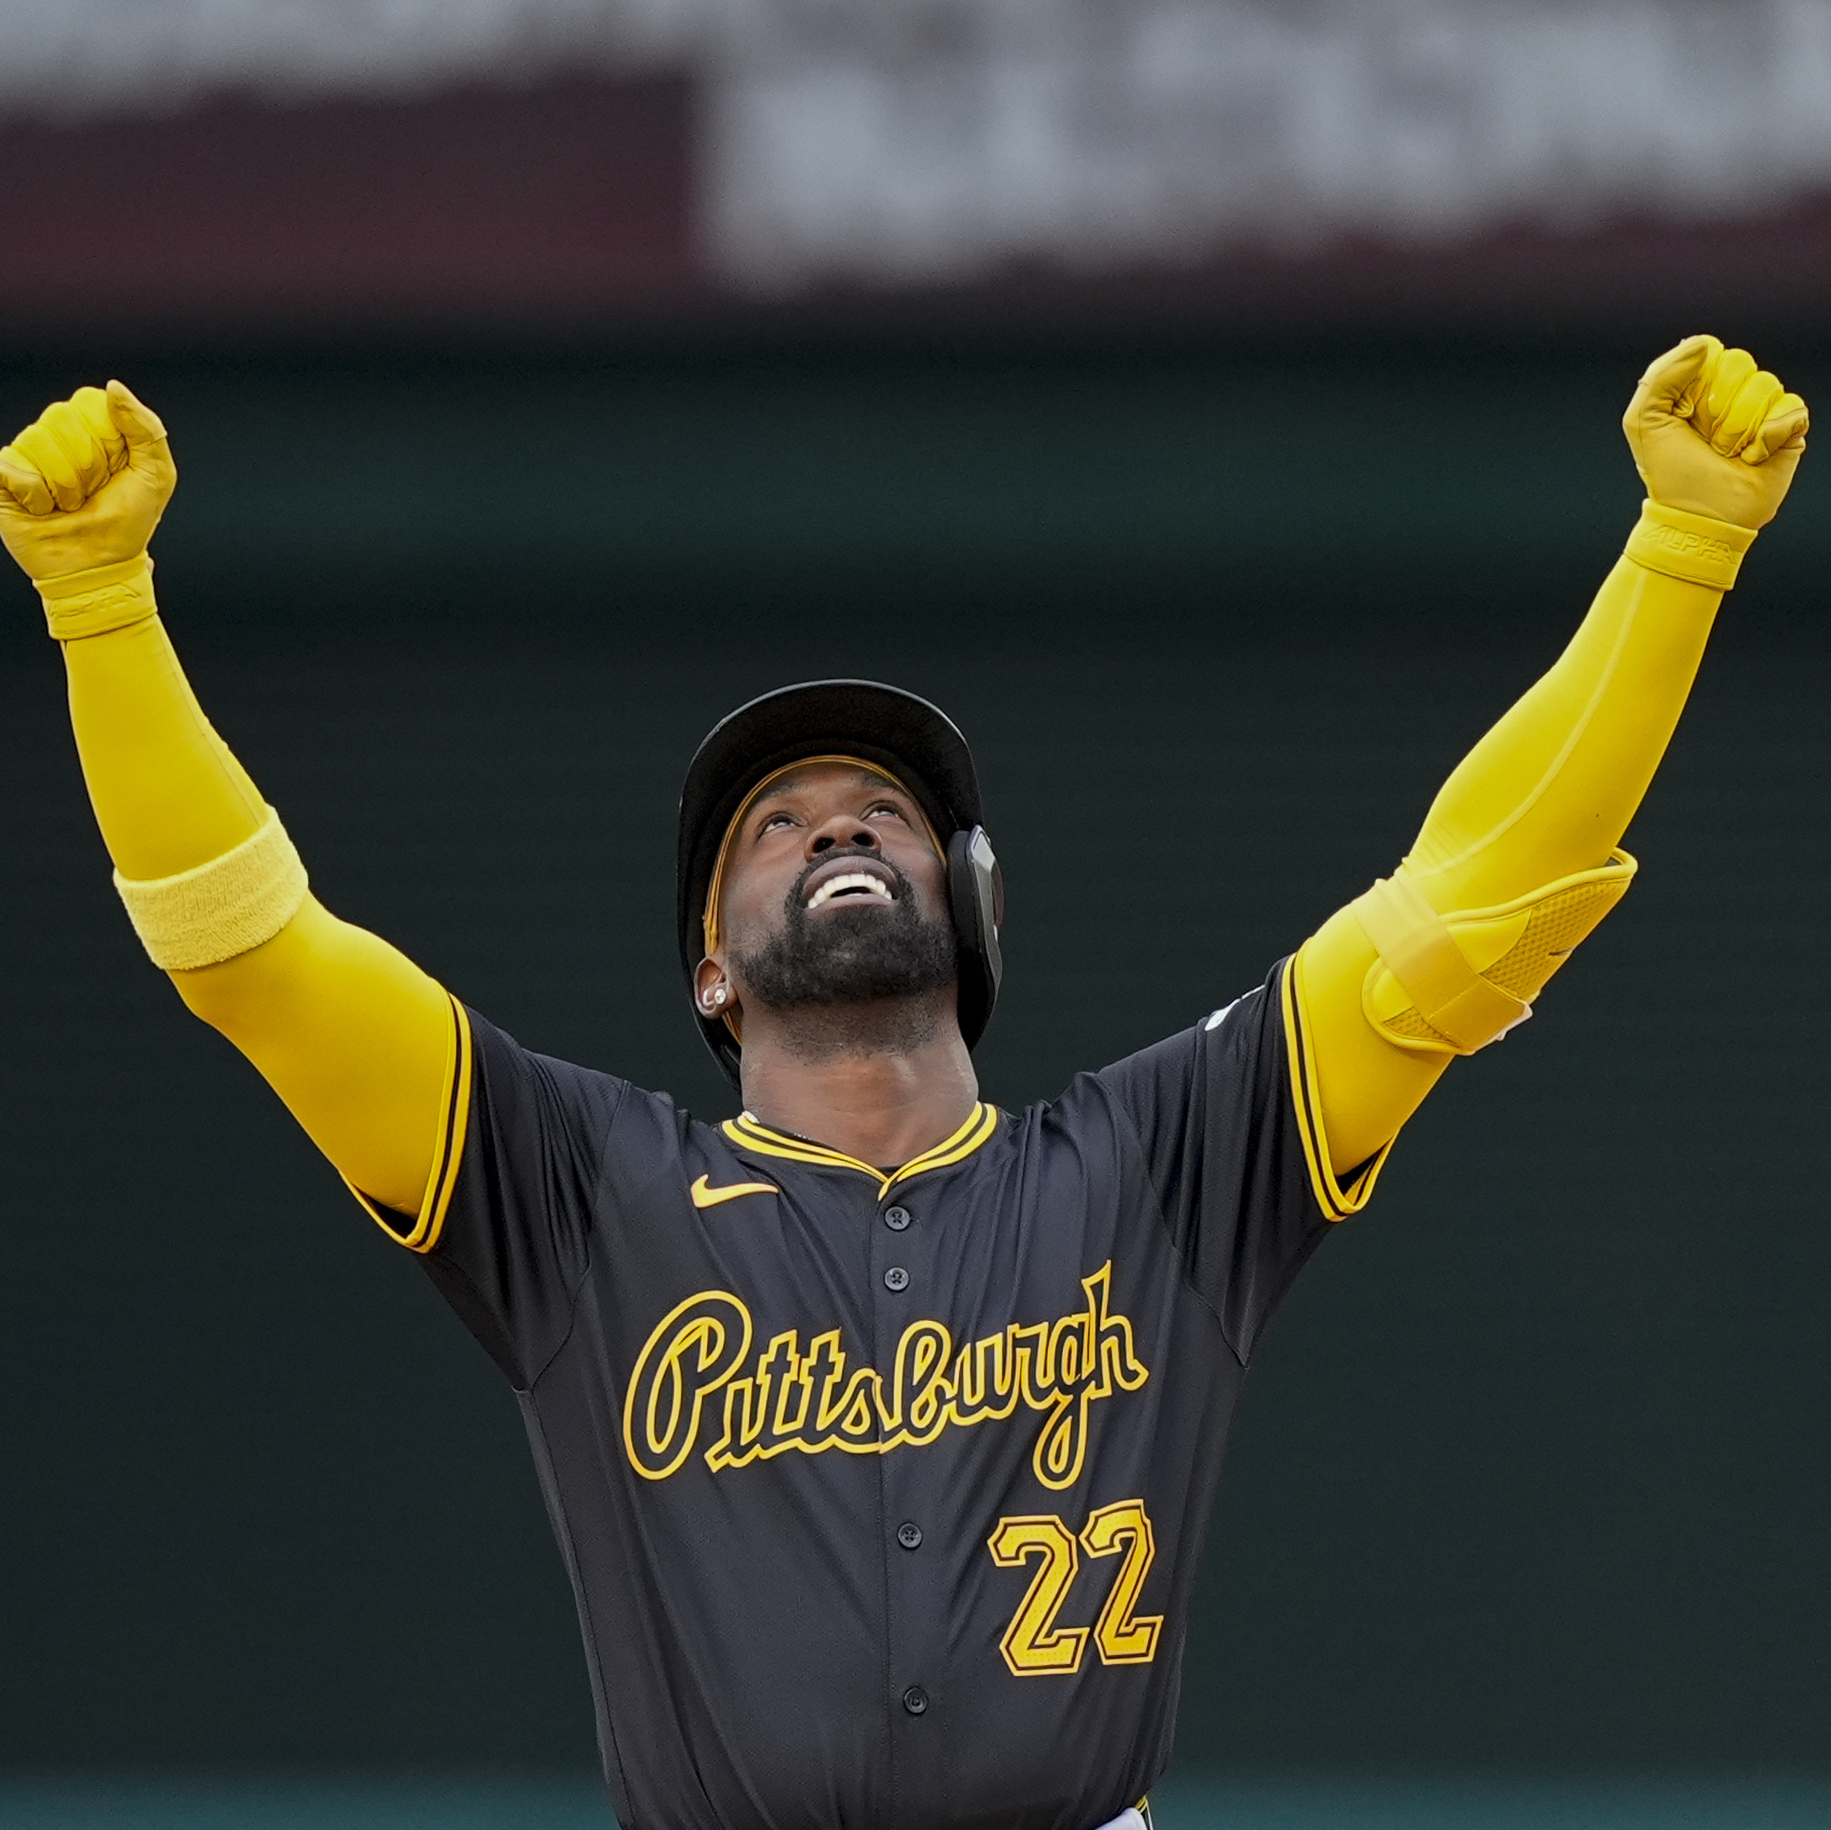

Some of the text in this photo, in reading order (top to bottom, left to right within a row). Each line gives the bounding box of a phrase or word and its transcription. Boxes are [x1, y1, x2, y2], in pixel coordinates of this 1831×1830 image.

[1642, 524, 1737, 565] ALPHA
[623, 1259, 1148, 1490] Pittsburgh
[987, 1499, 1163, 1676] 22
